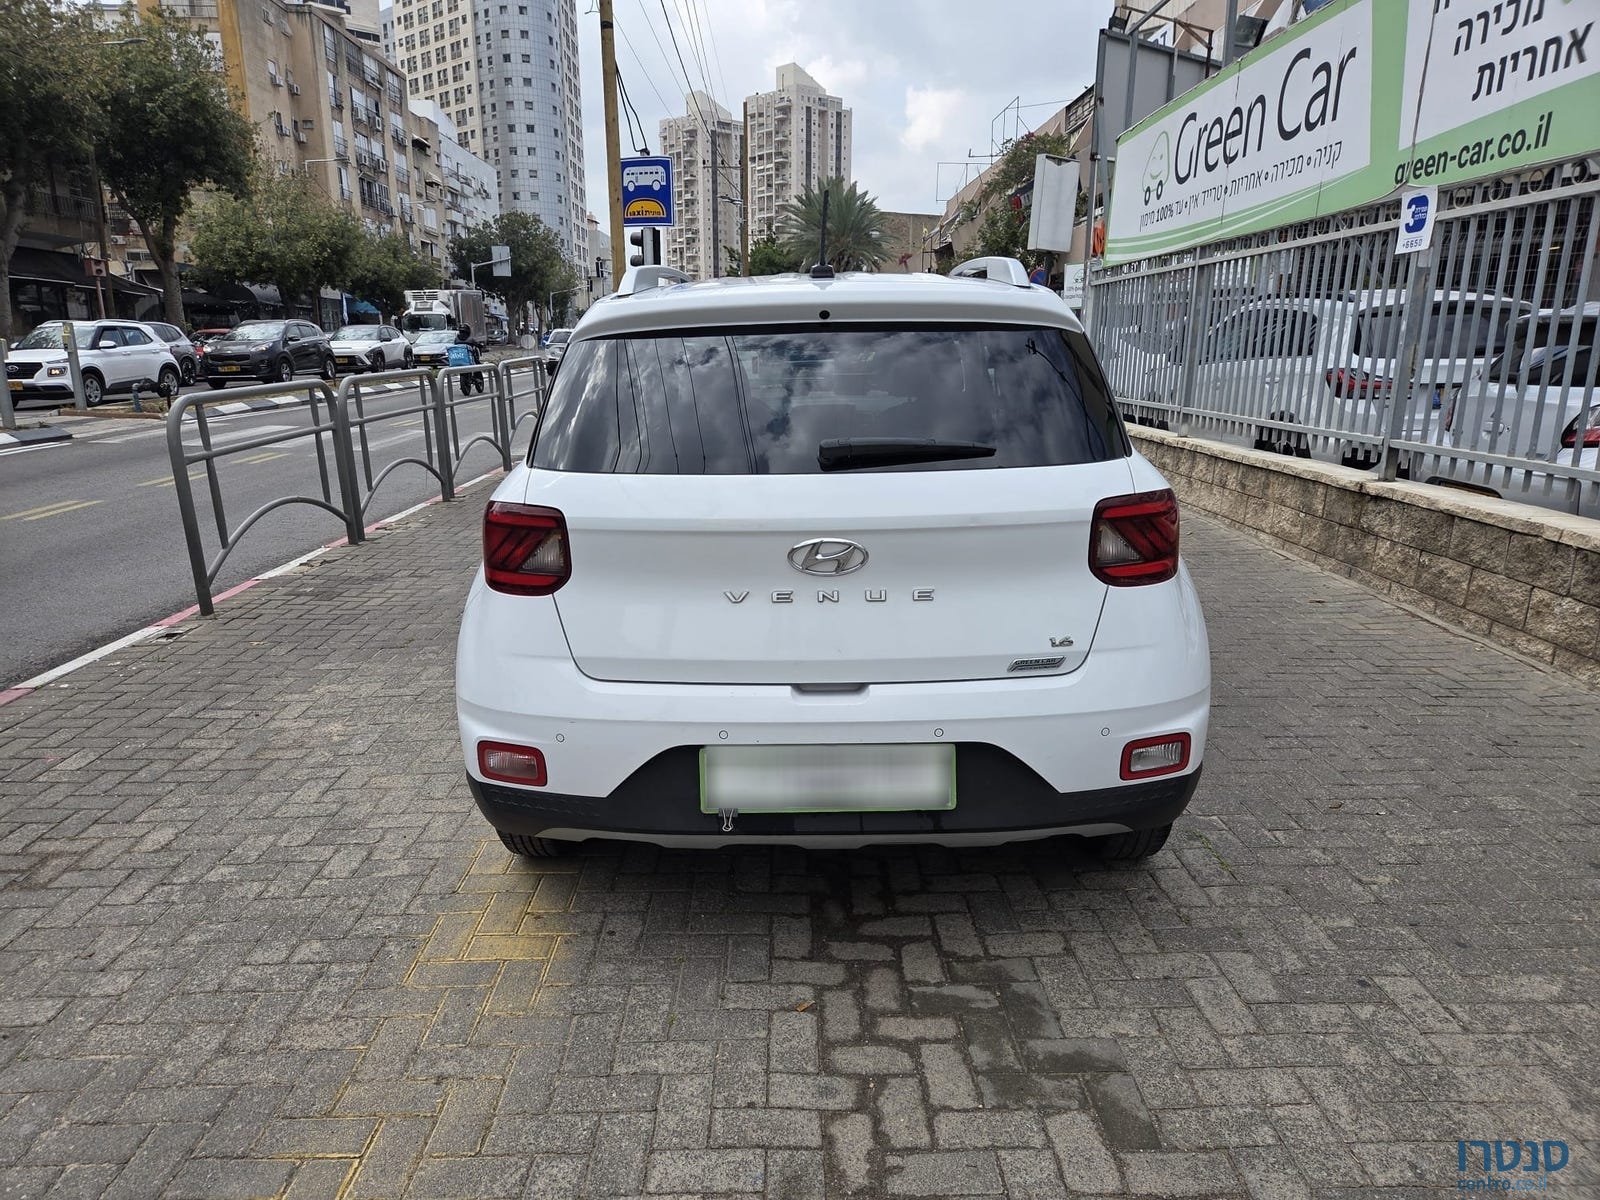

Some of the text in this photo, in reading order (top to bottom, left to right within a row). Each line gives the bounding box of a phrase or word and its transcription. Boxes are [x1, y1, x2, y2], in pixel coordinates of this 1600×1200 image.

[1471, 21, 1596, 102] אחריות
[1174, 46, 1357, 185] Green Car
[1271, 154, 1304, 183] מכירה
[1313, 141, 1343, 169] קניה
[1228, 169, 1264, 197] אחריות
[1156, 203, 1174, 223] 100%
[723, 588, 935, 604] VENUE
